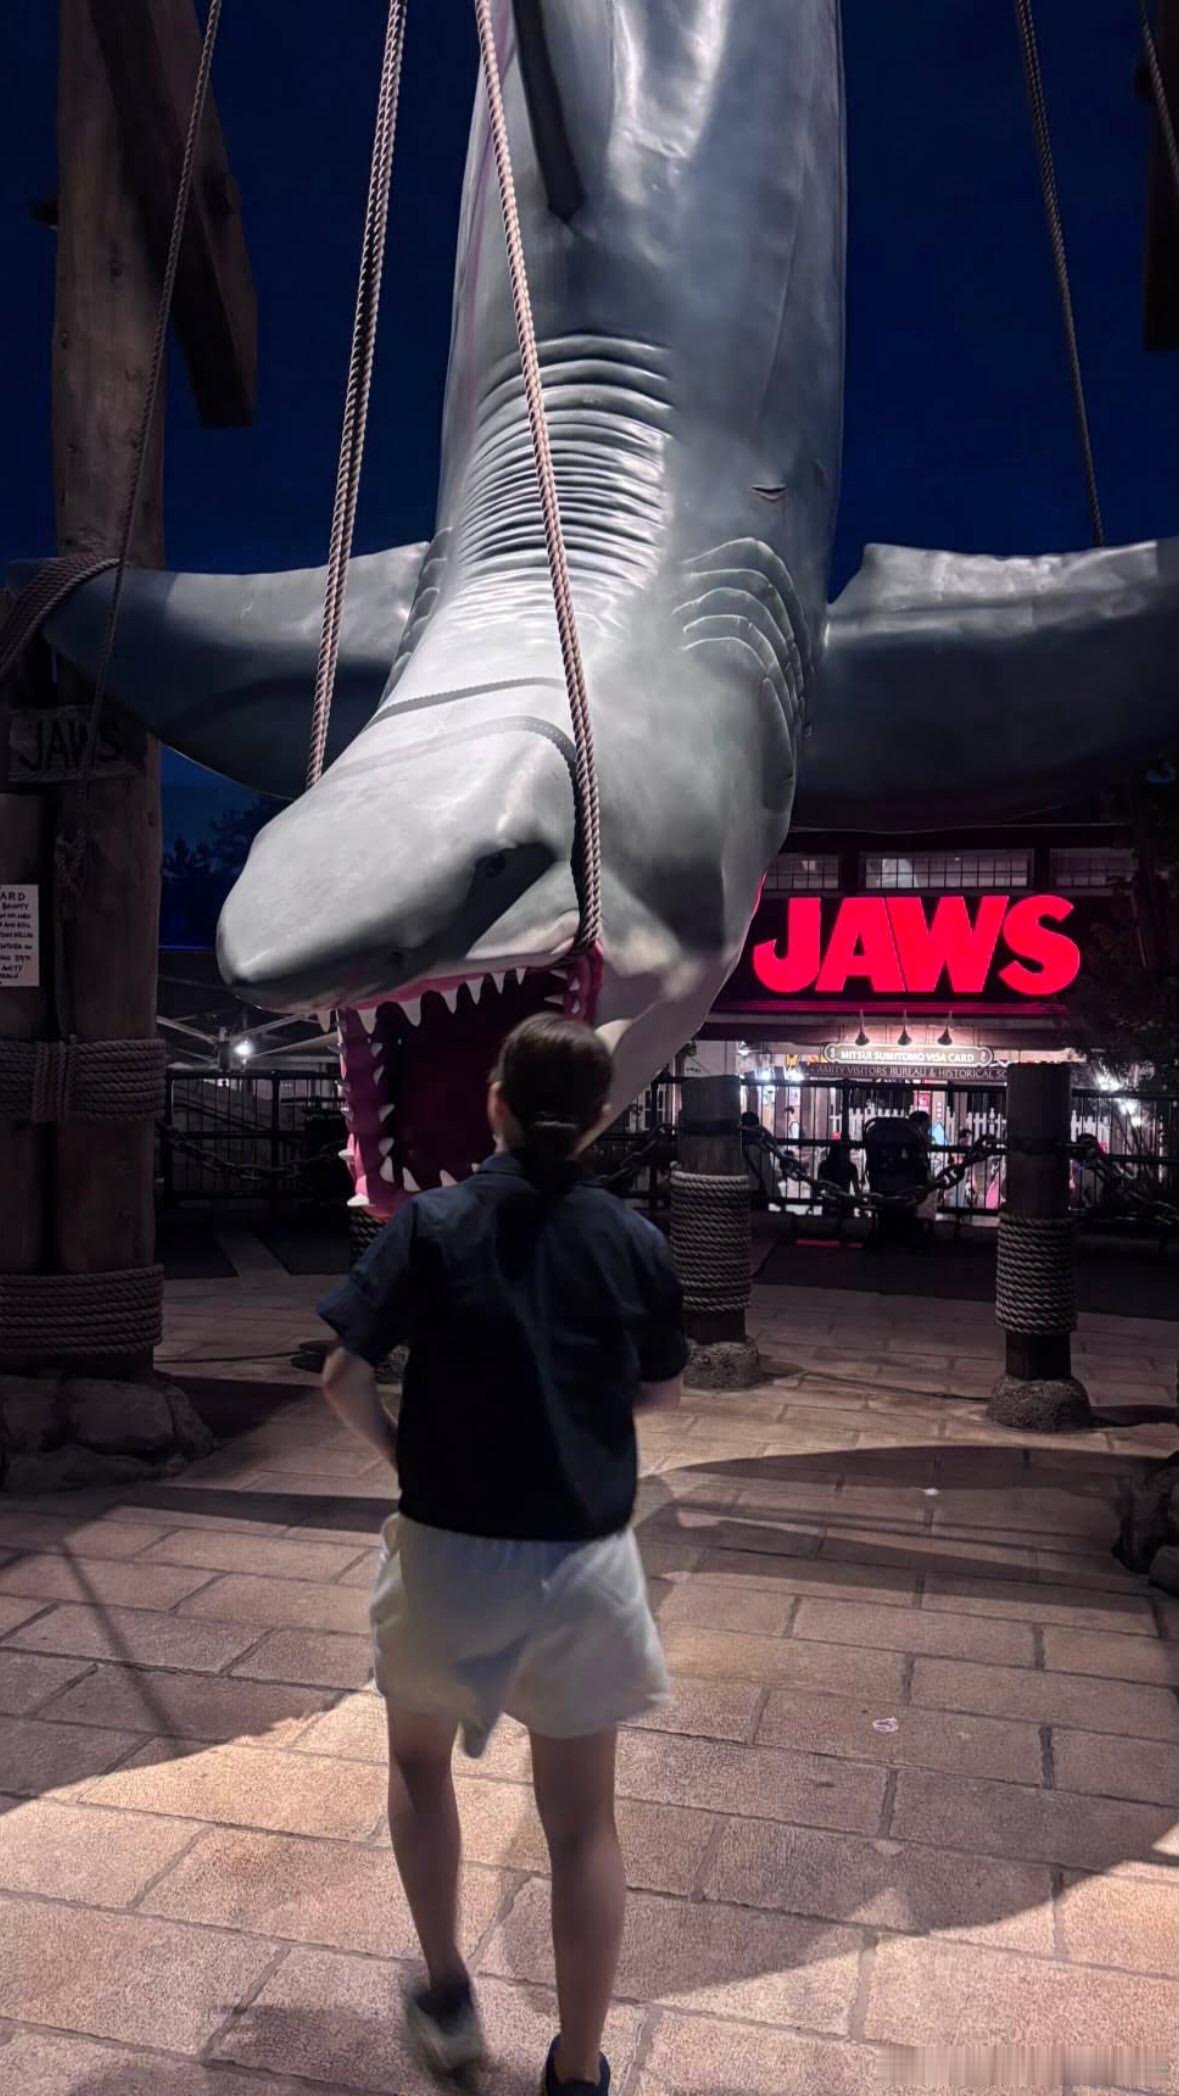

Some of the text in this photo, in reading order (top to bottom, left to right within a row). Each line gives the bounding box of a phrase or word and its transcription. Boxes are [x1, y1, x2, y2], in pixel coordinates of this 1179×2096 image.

[18, 719, 121, 772] JAWS
[753, 894, 1081, 996] JAWS
[817, 1066, 844, 1075] AMITY
[847, 1066, 887, 1077] VISITORS
[890, 1067, 926, 1078] BUREAU
[929, 1068, 936, 1078] &
[939, 1069, 993, 1080] HISTORICAL
[840, 1050, 975, 1063] MITSUI SUMITOMO VISA CARD
